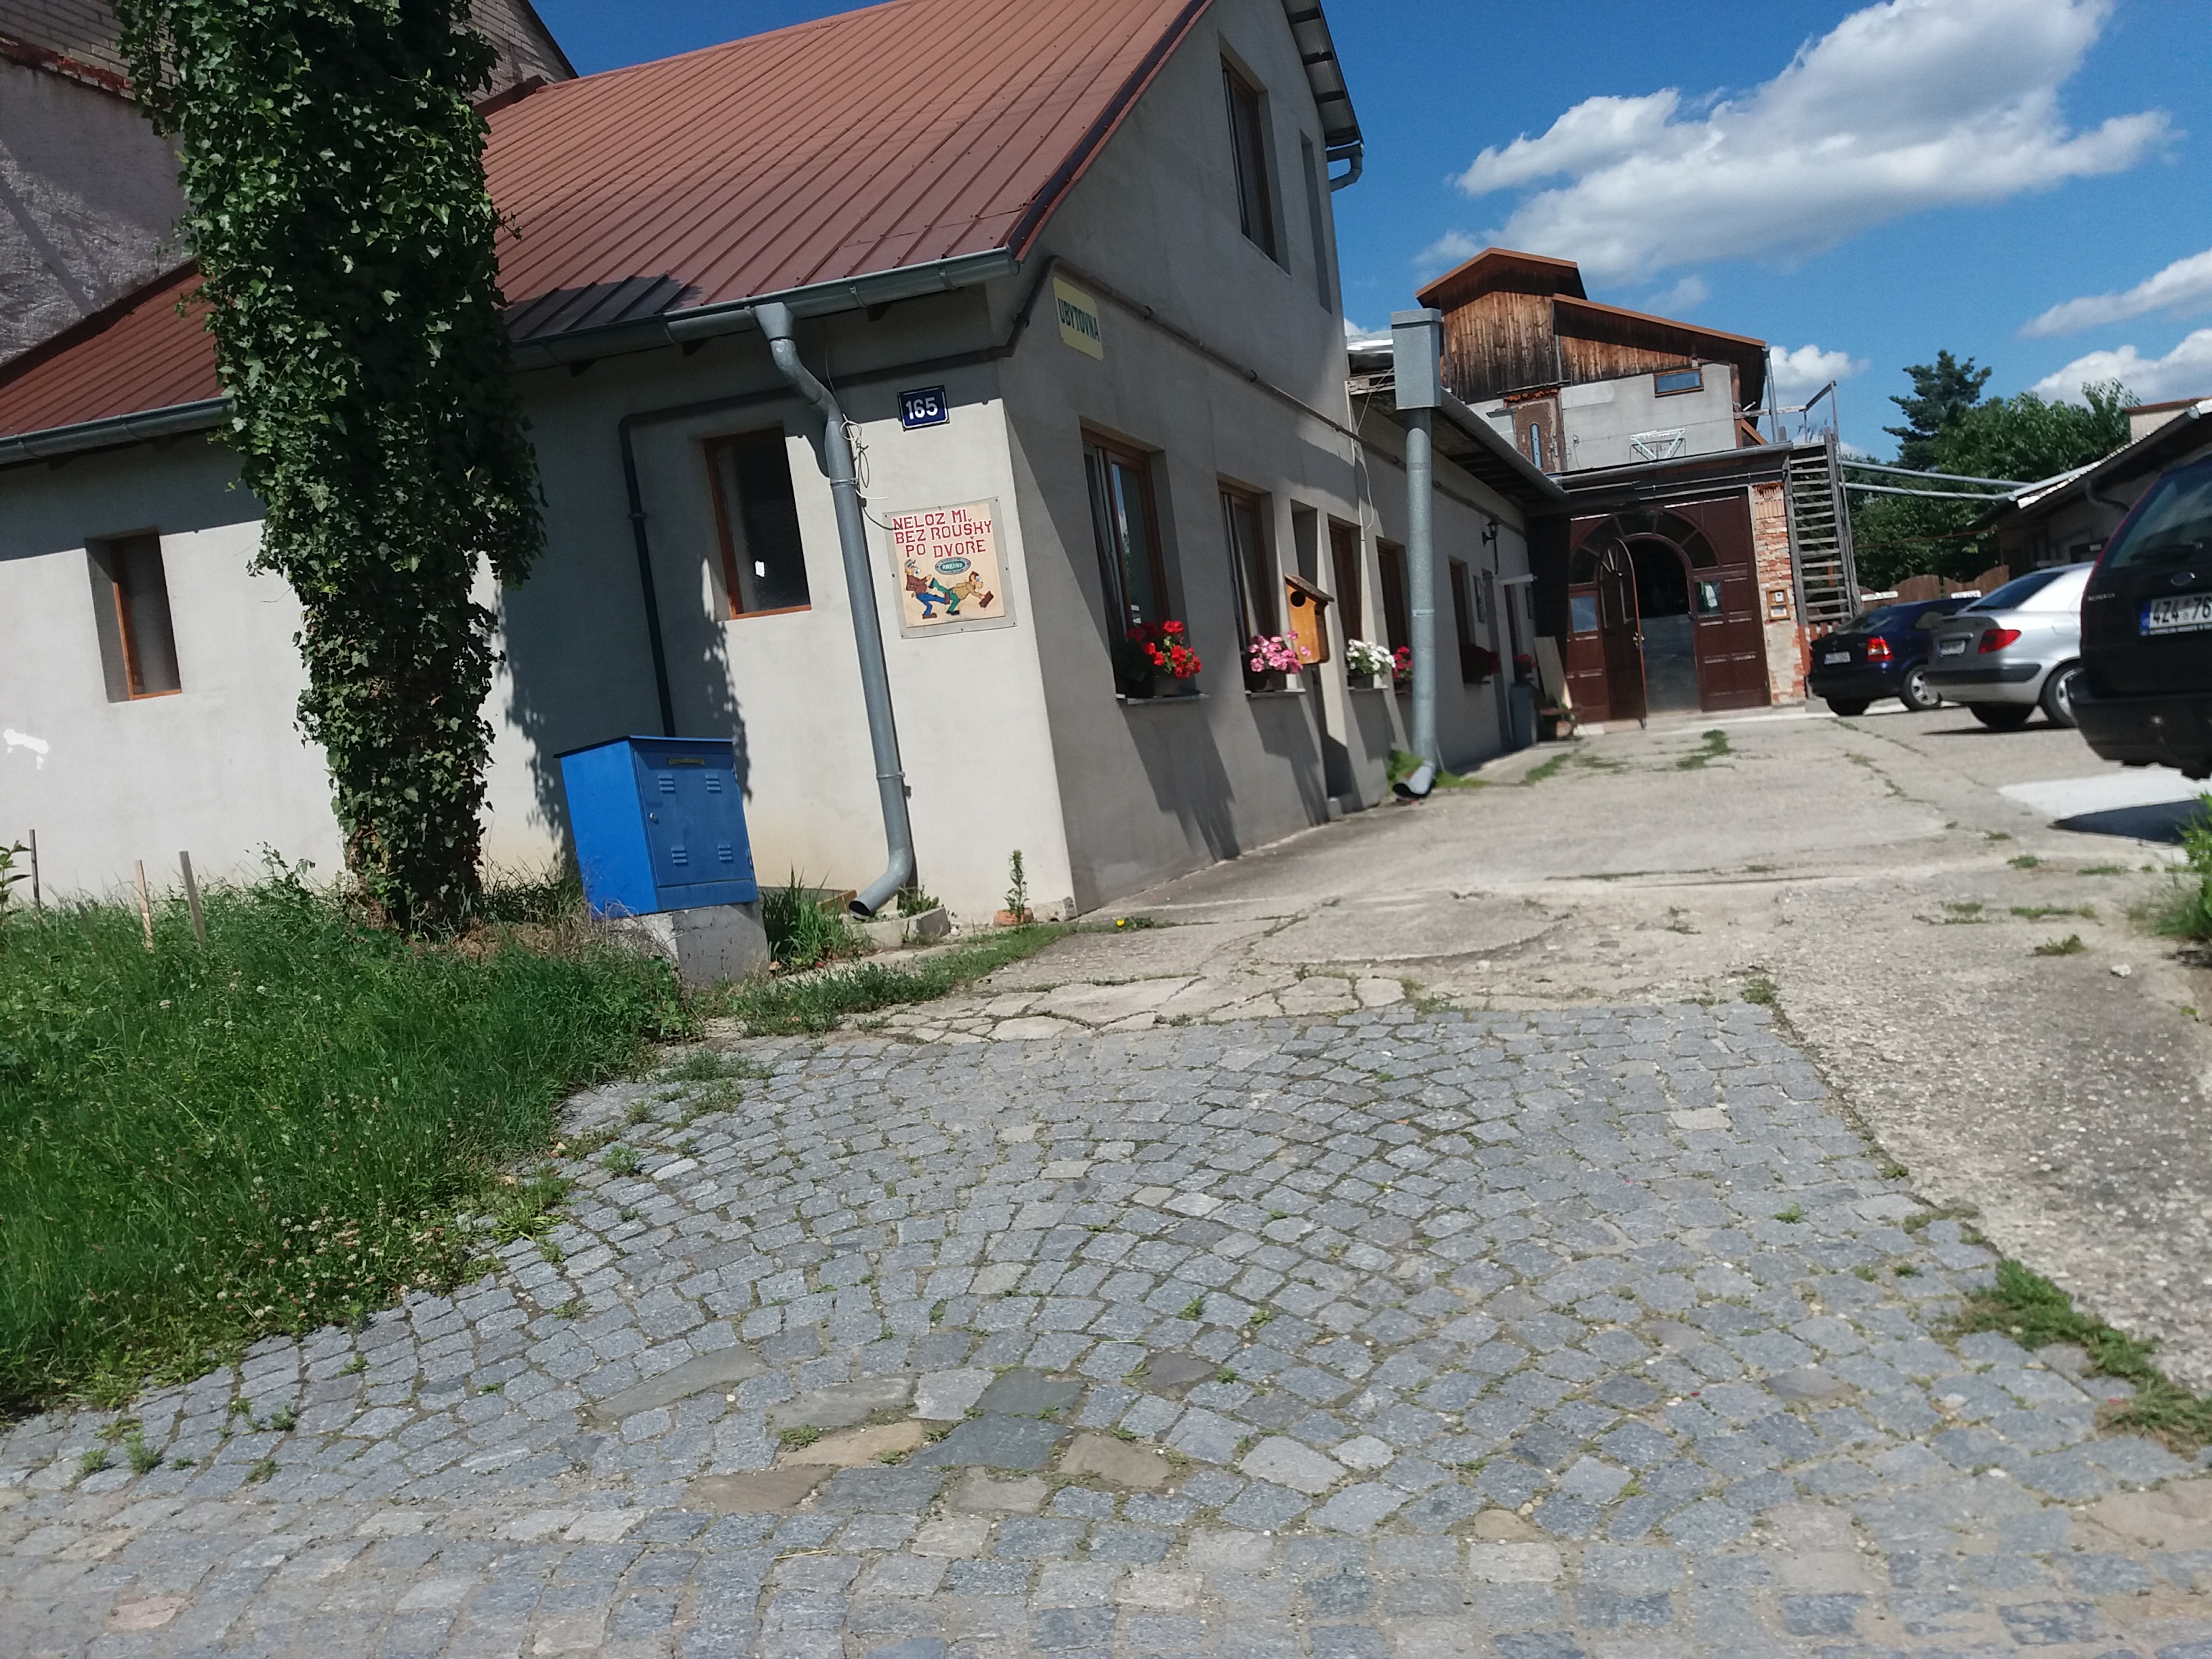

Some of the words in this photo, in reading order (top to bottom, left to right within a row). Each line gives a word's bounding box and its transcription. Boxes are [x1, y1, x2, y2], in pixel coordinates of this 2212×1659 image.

[1057, 298, 1100, 342] UBYTOVNA
[905, 396, 938, 420] 165
[893, 512, 946, 531] NELOZ
[951, 509, 968, 523] MI
[895, 529, 926, 545] BEZ
[930, 518, 992, 541] ROUŠKY
[905, 544, 926, 558] PO
[933, 536, 987, 558] DVOŘE
